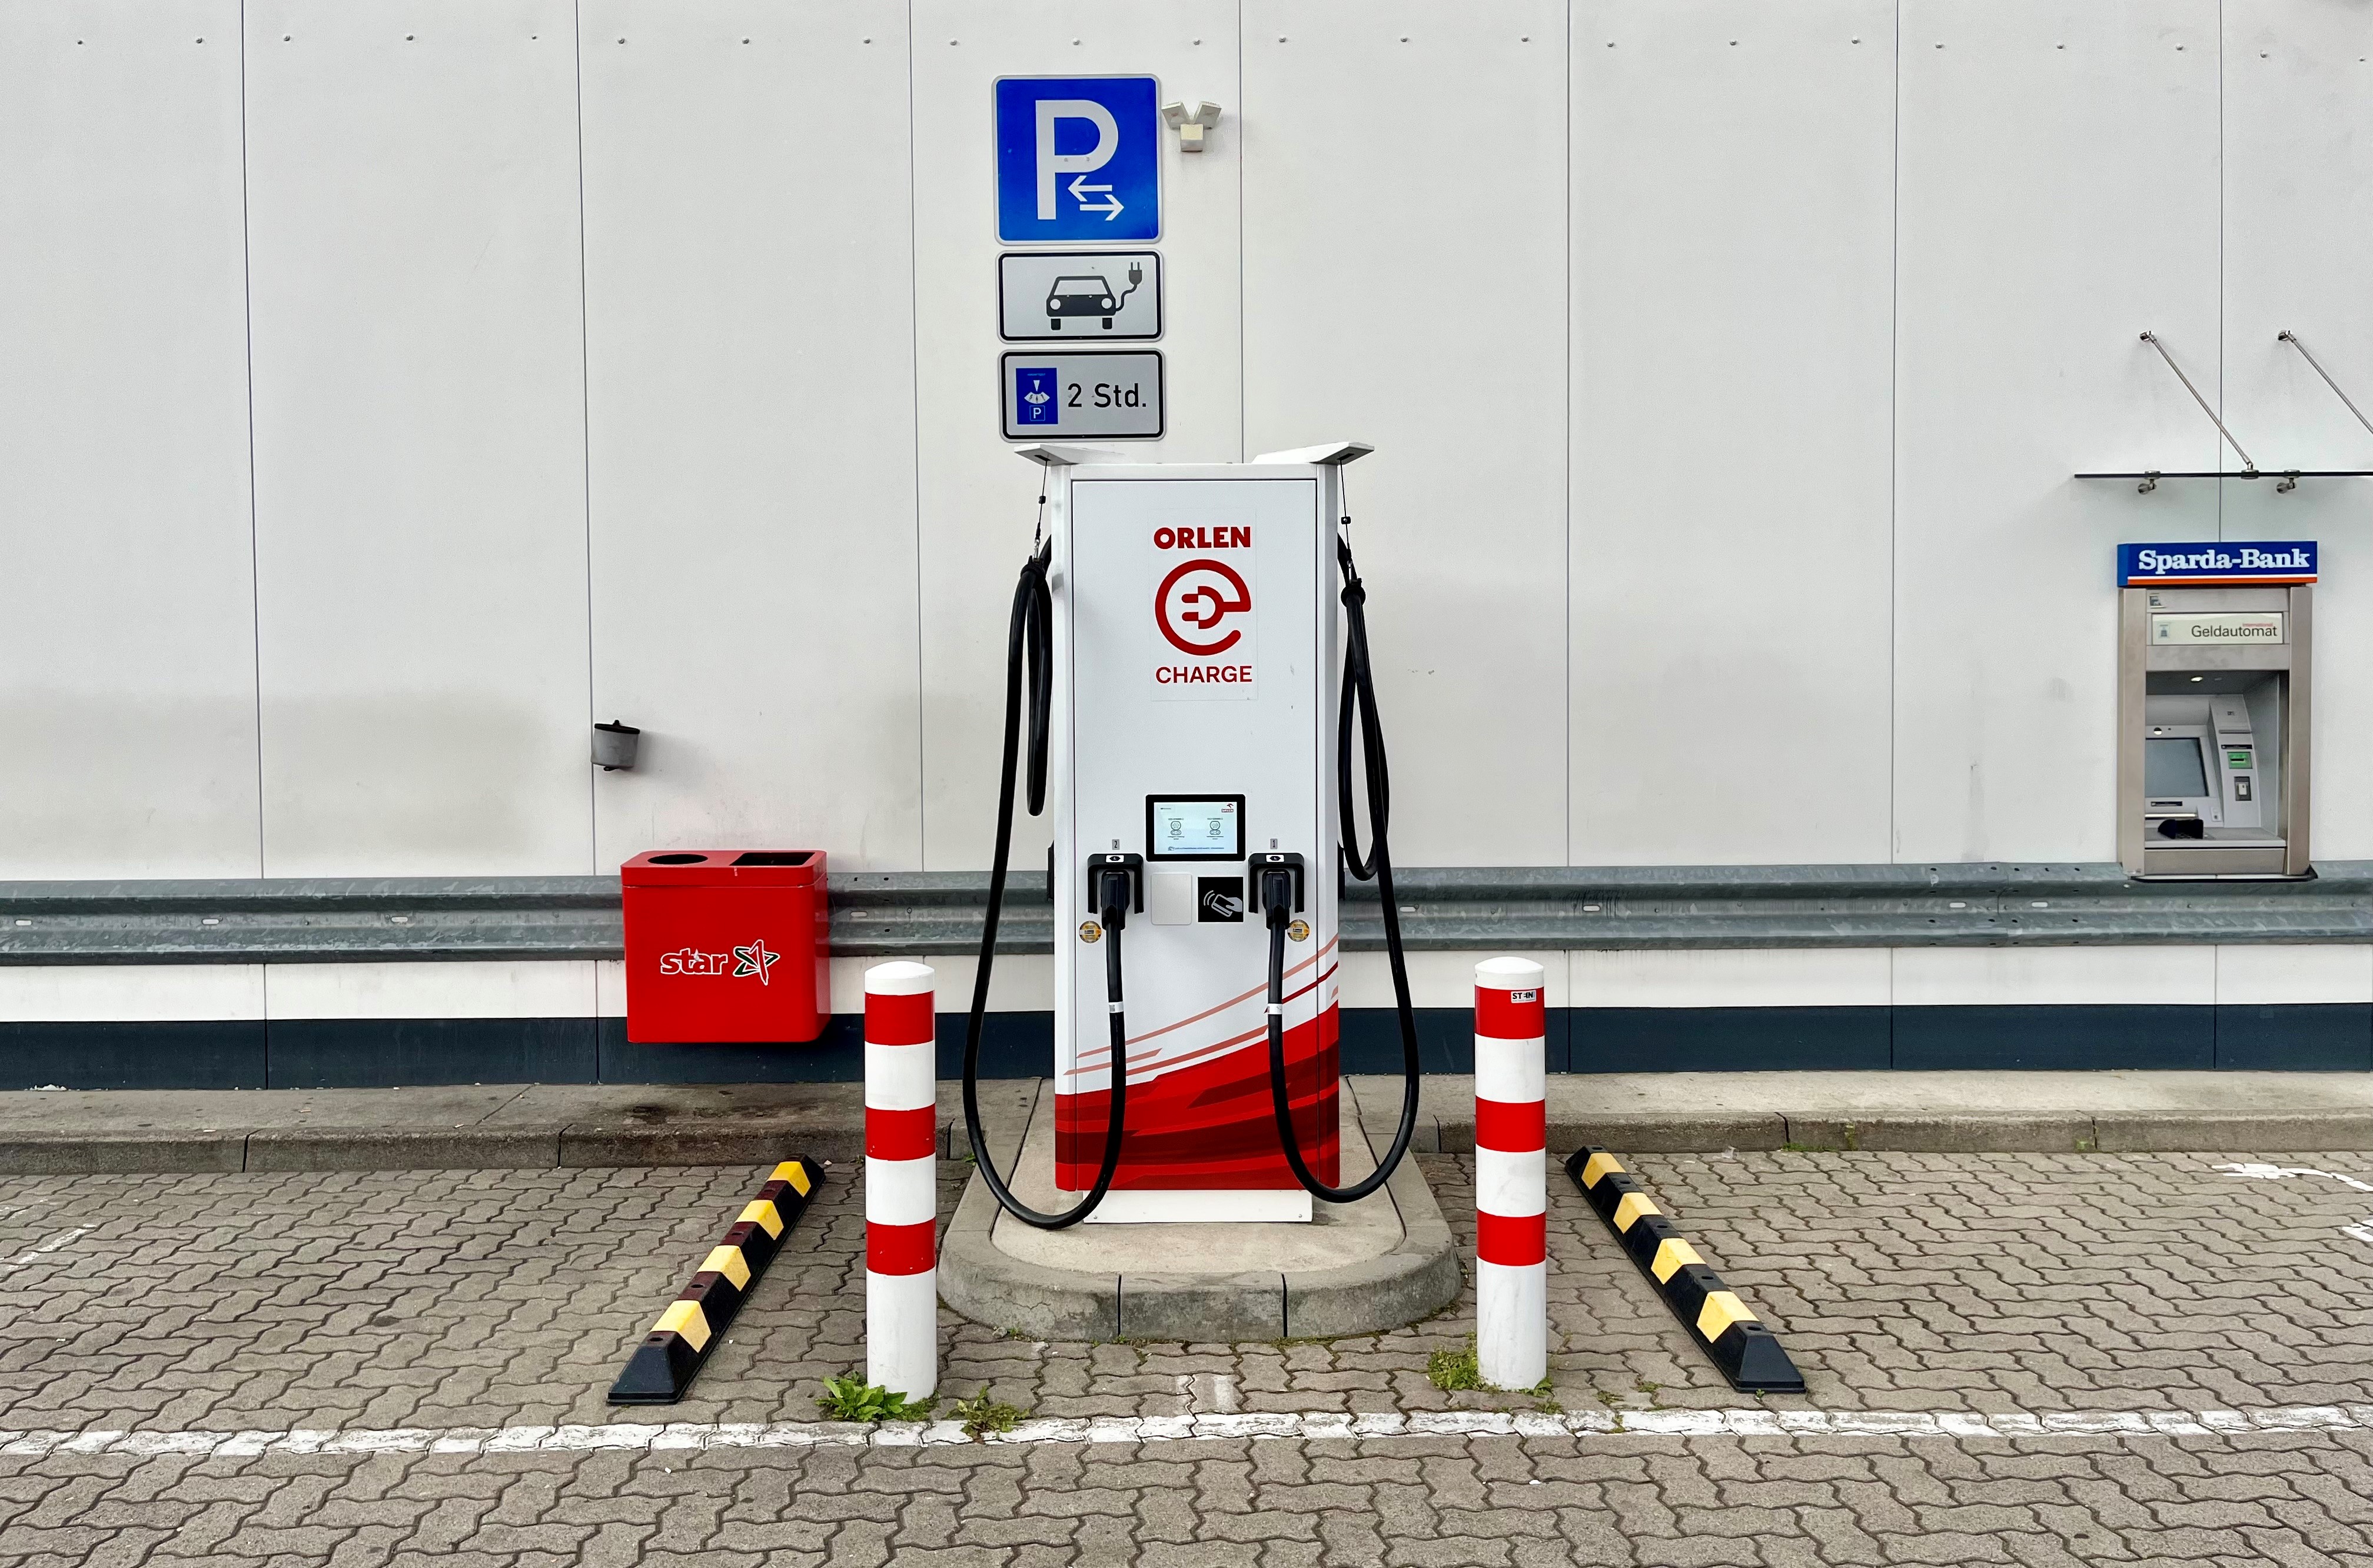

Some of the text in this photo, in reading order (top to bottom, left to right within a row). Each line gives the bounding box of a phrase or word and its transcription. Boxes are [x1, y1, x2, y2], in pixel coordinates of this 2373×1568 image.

[1035, 100, 1119, 220] P
[1068, 383, 1146, 408] 2 Std.
[1033, 407, 1041, 419] P
[1154, 527, 1251, 549] ORLEN
[2139, 548, 2310, 574] Sparda-Bank
[2191, 625, 2277, 637] Geldautomat
[1156, 665, 1252, 684] CHARGE
[660, 948, 728, 974] star
